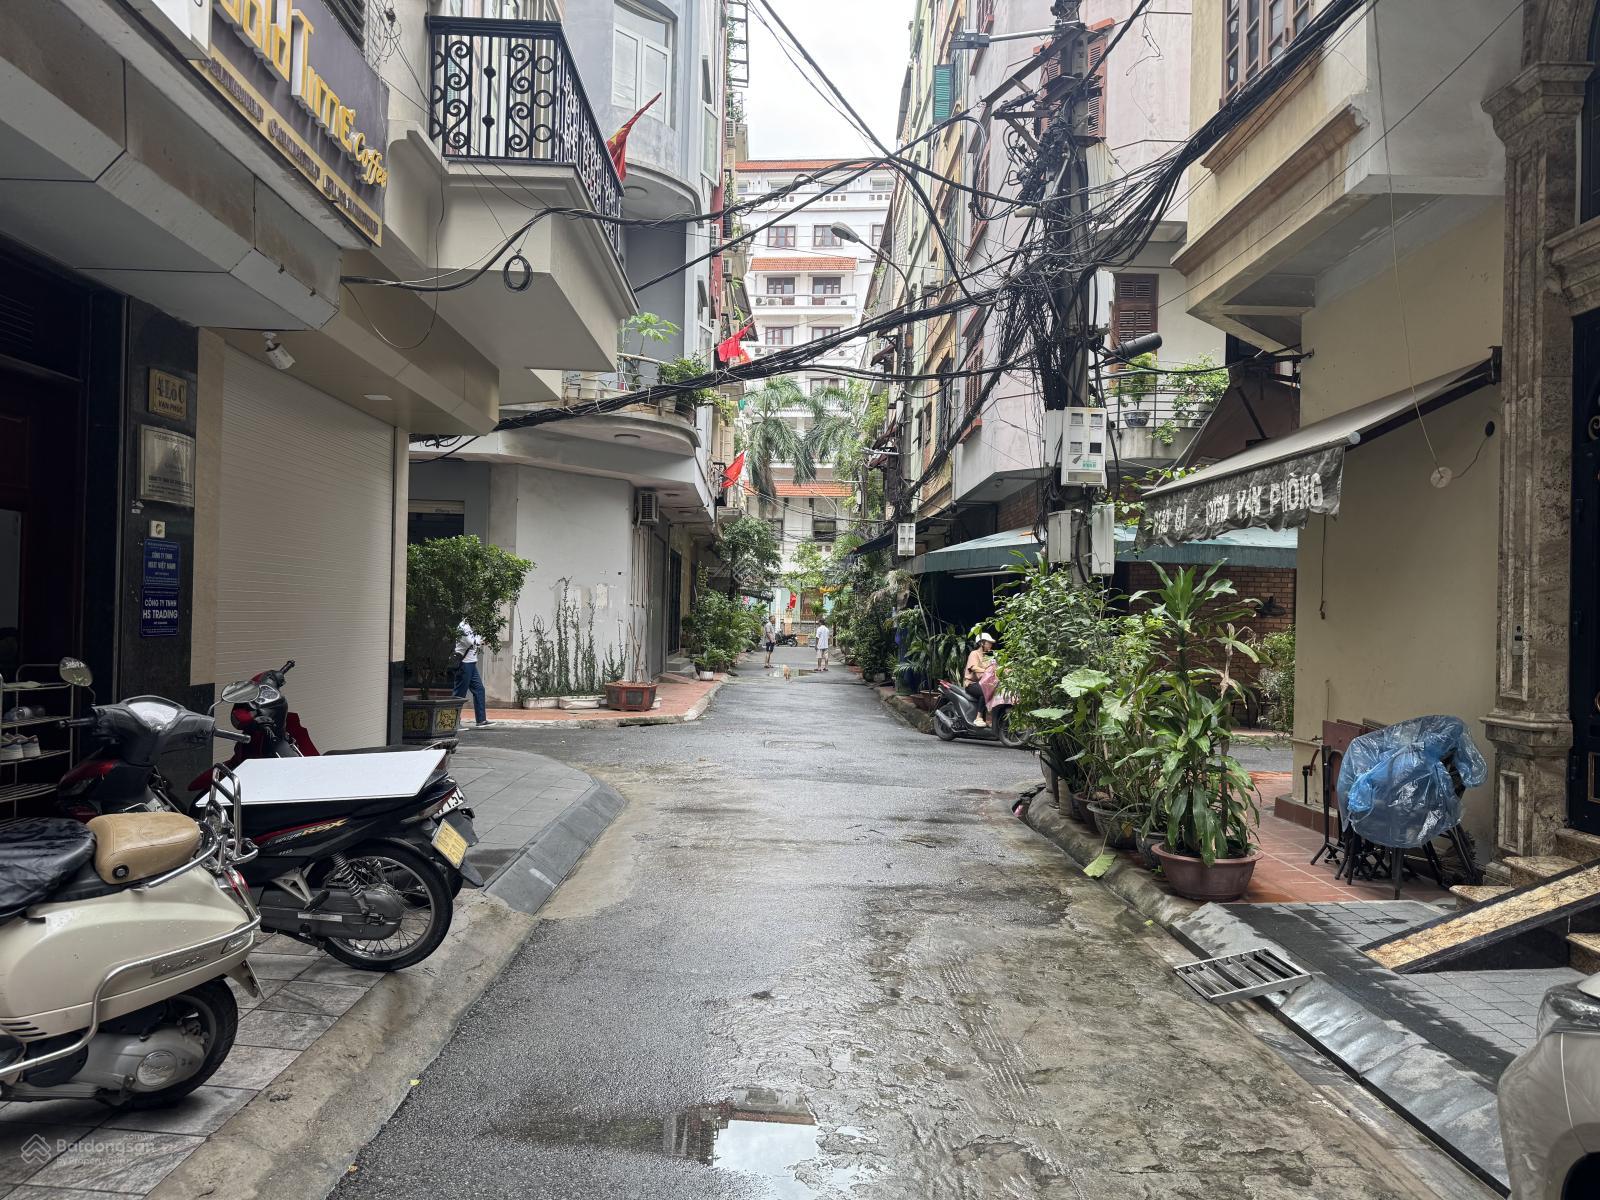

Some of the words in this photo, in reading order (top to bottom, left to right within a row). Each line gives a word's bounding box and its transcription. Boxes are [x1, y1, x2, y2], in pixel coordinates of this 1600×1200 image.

[354, 132, 388, 187] Coffee
[1270, 471, 1324, 514] PHÒNG
[142, 609, 151, 619] HS
[152, 609, 177, 619] TRADING
